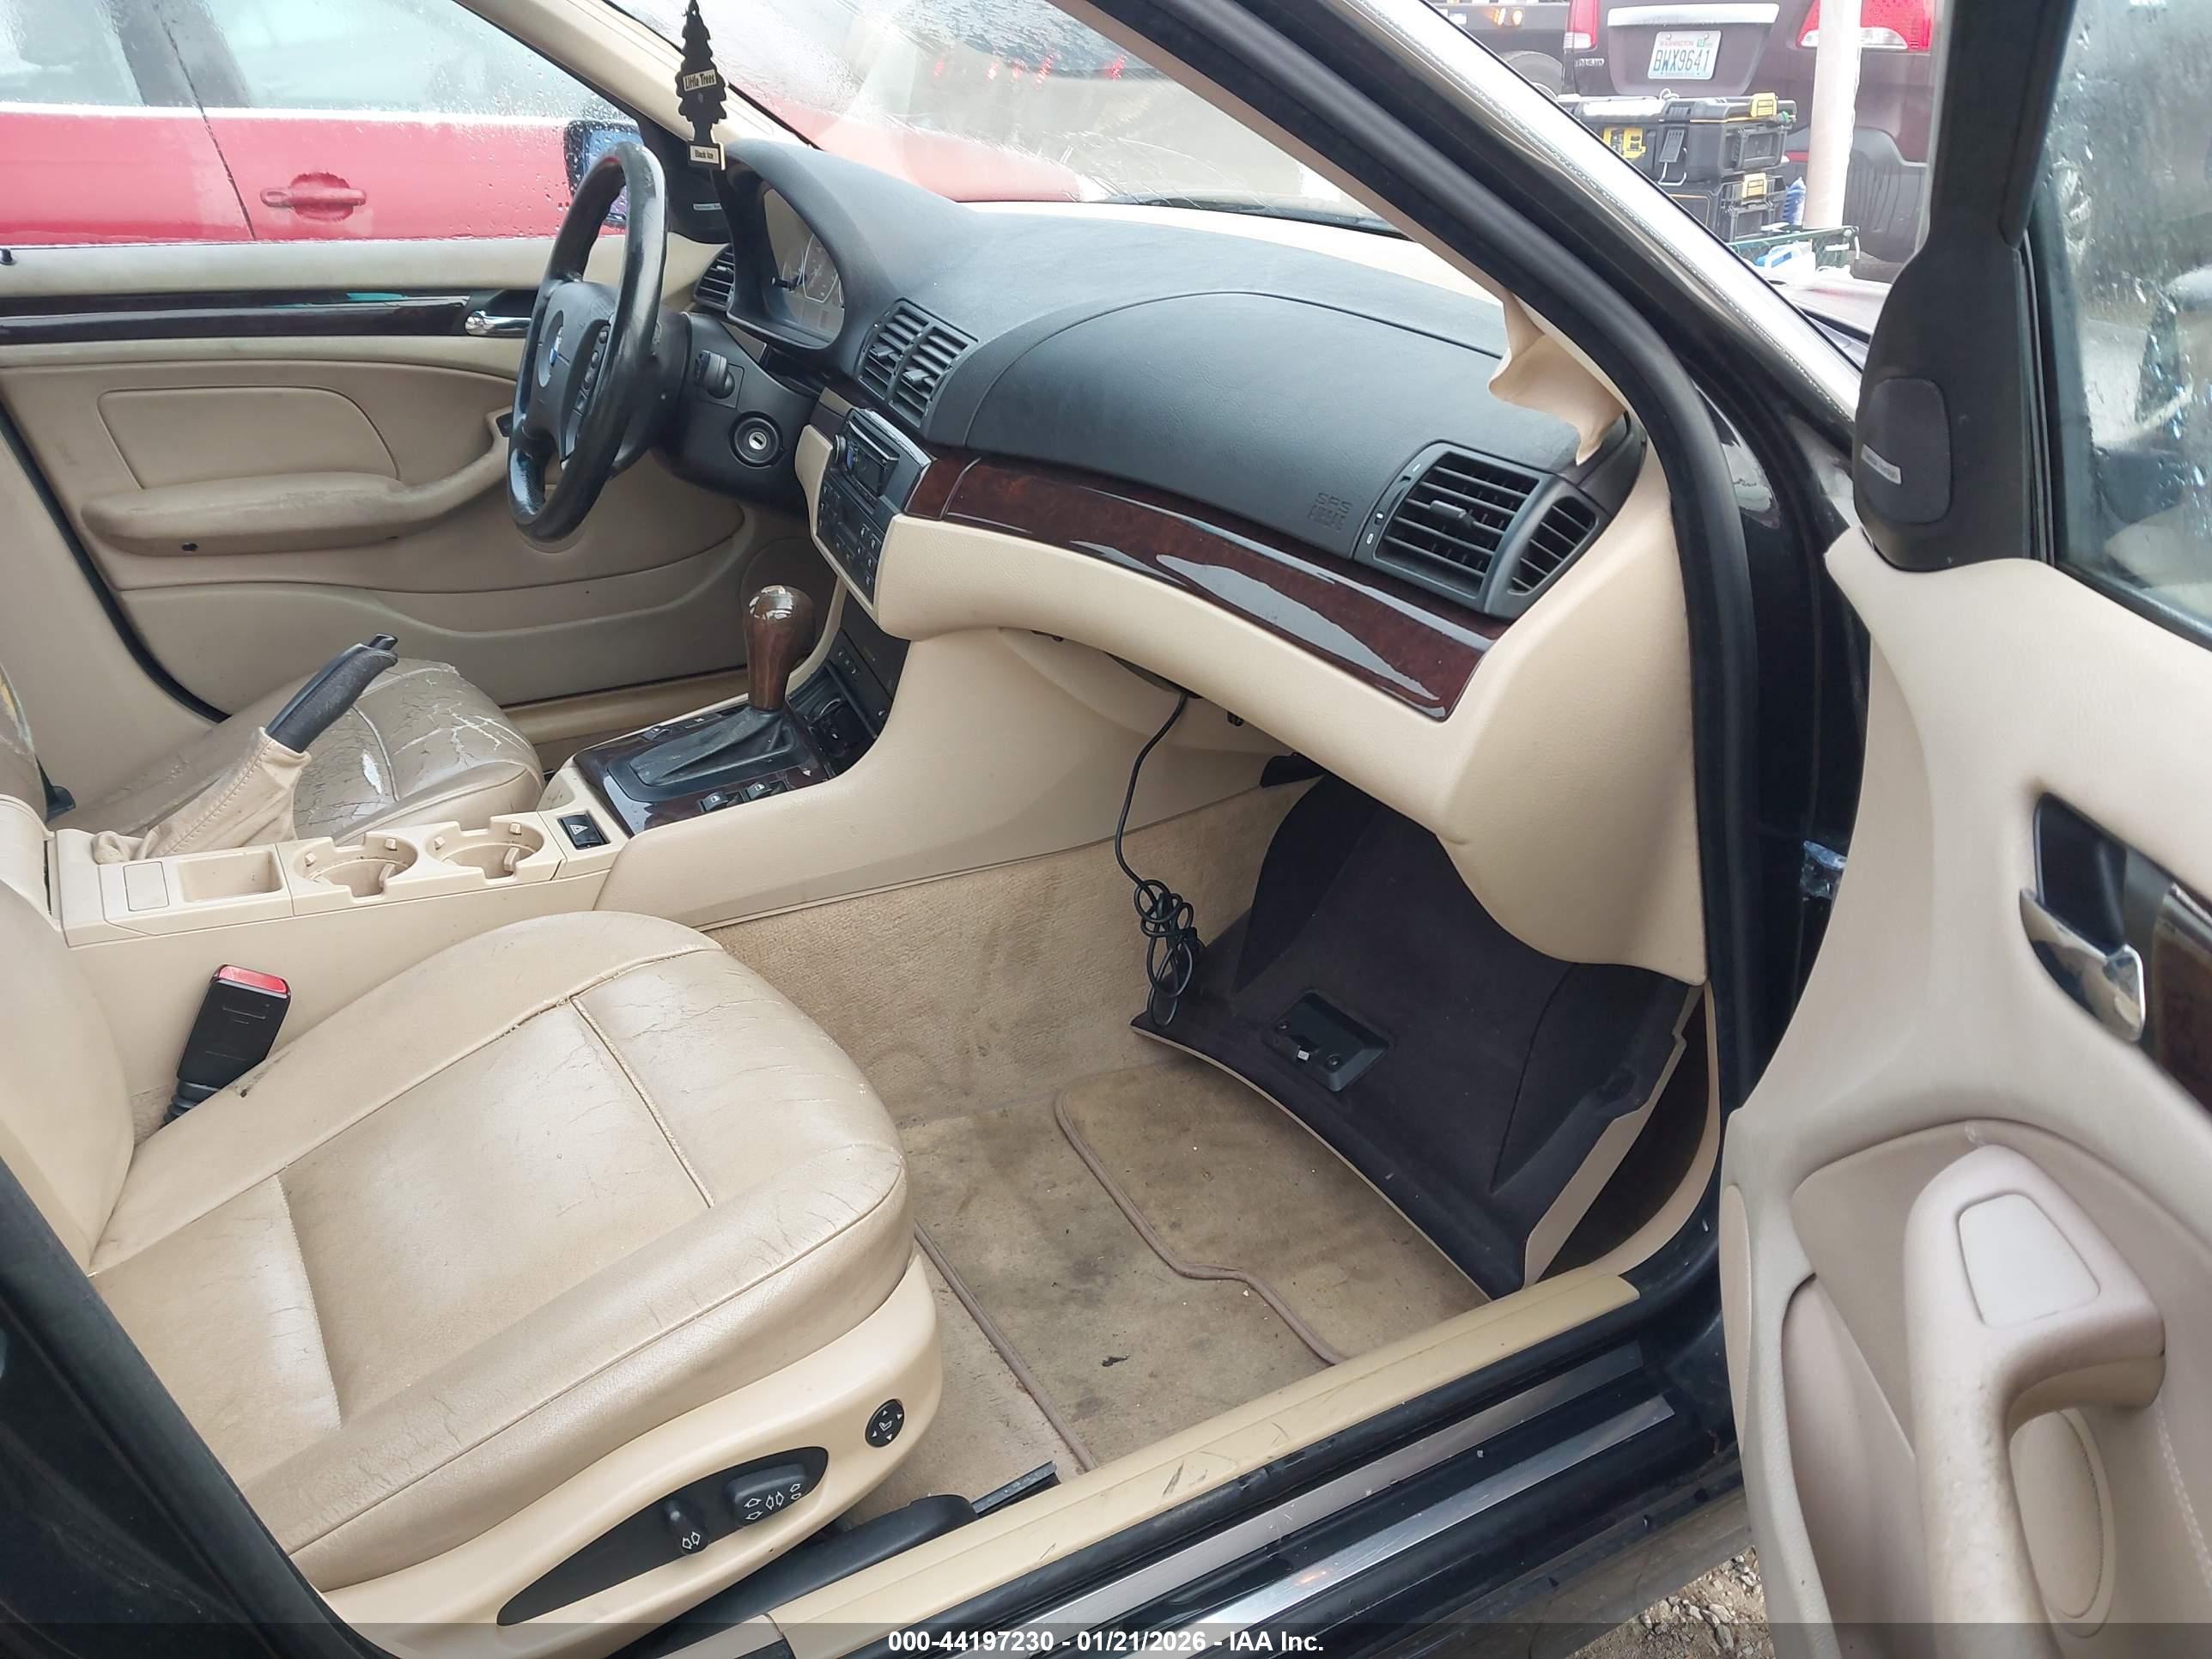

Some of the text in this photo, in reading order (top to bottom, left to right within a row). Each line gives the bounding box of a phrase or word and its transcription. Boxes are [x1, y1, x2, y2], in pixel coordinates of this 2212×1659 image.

[1653, 49, 1711, 72] BWX9641
[684, 72, 715, 90] Little Trees
[694, 149, 707, 159] Black
